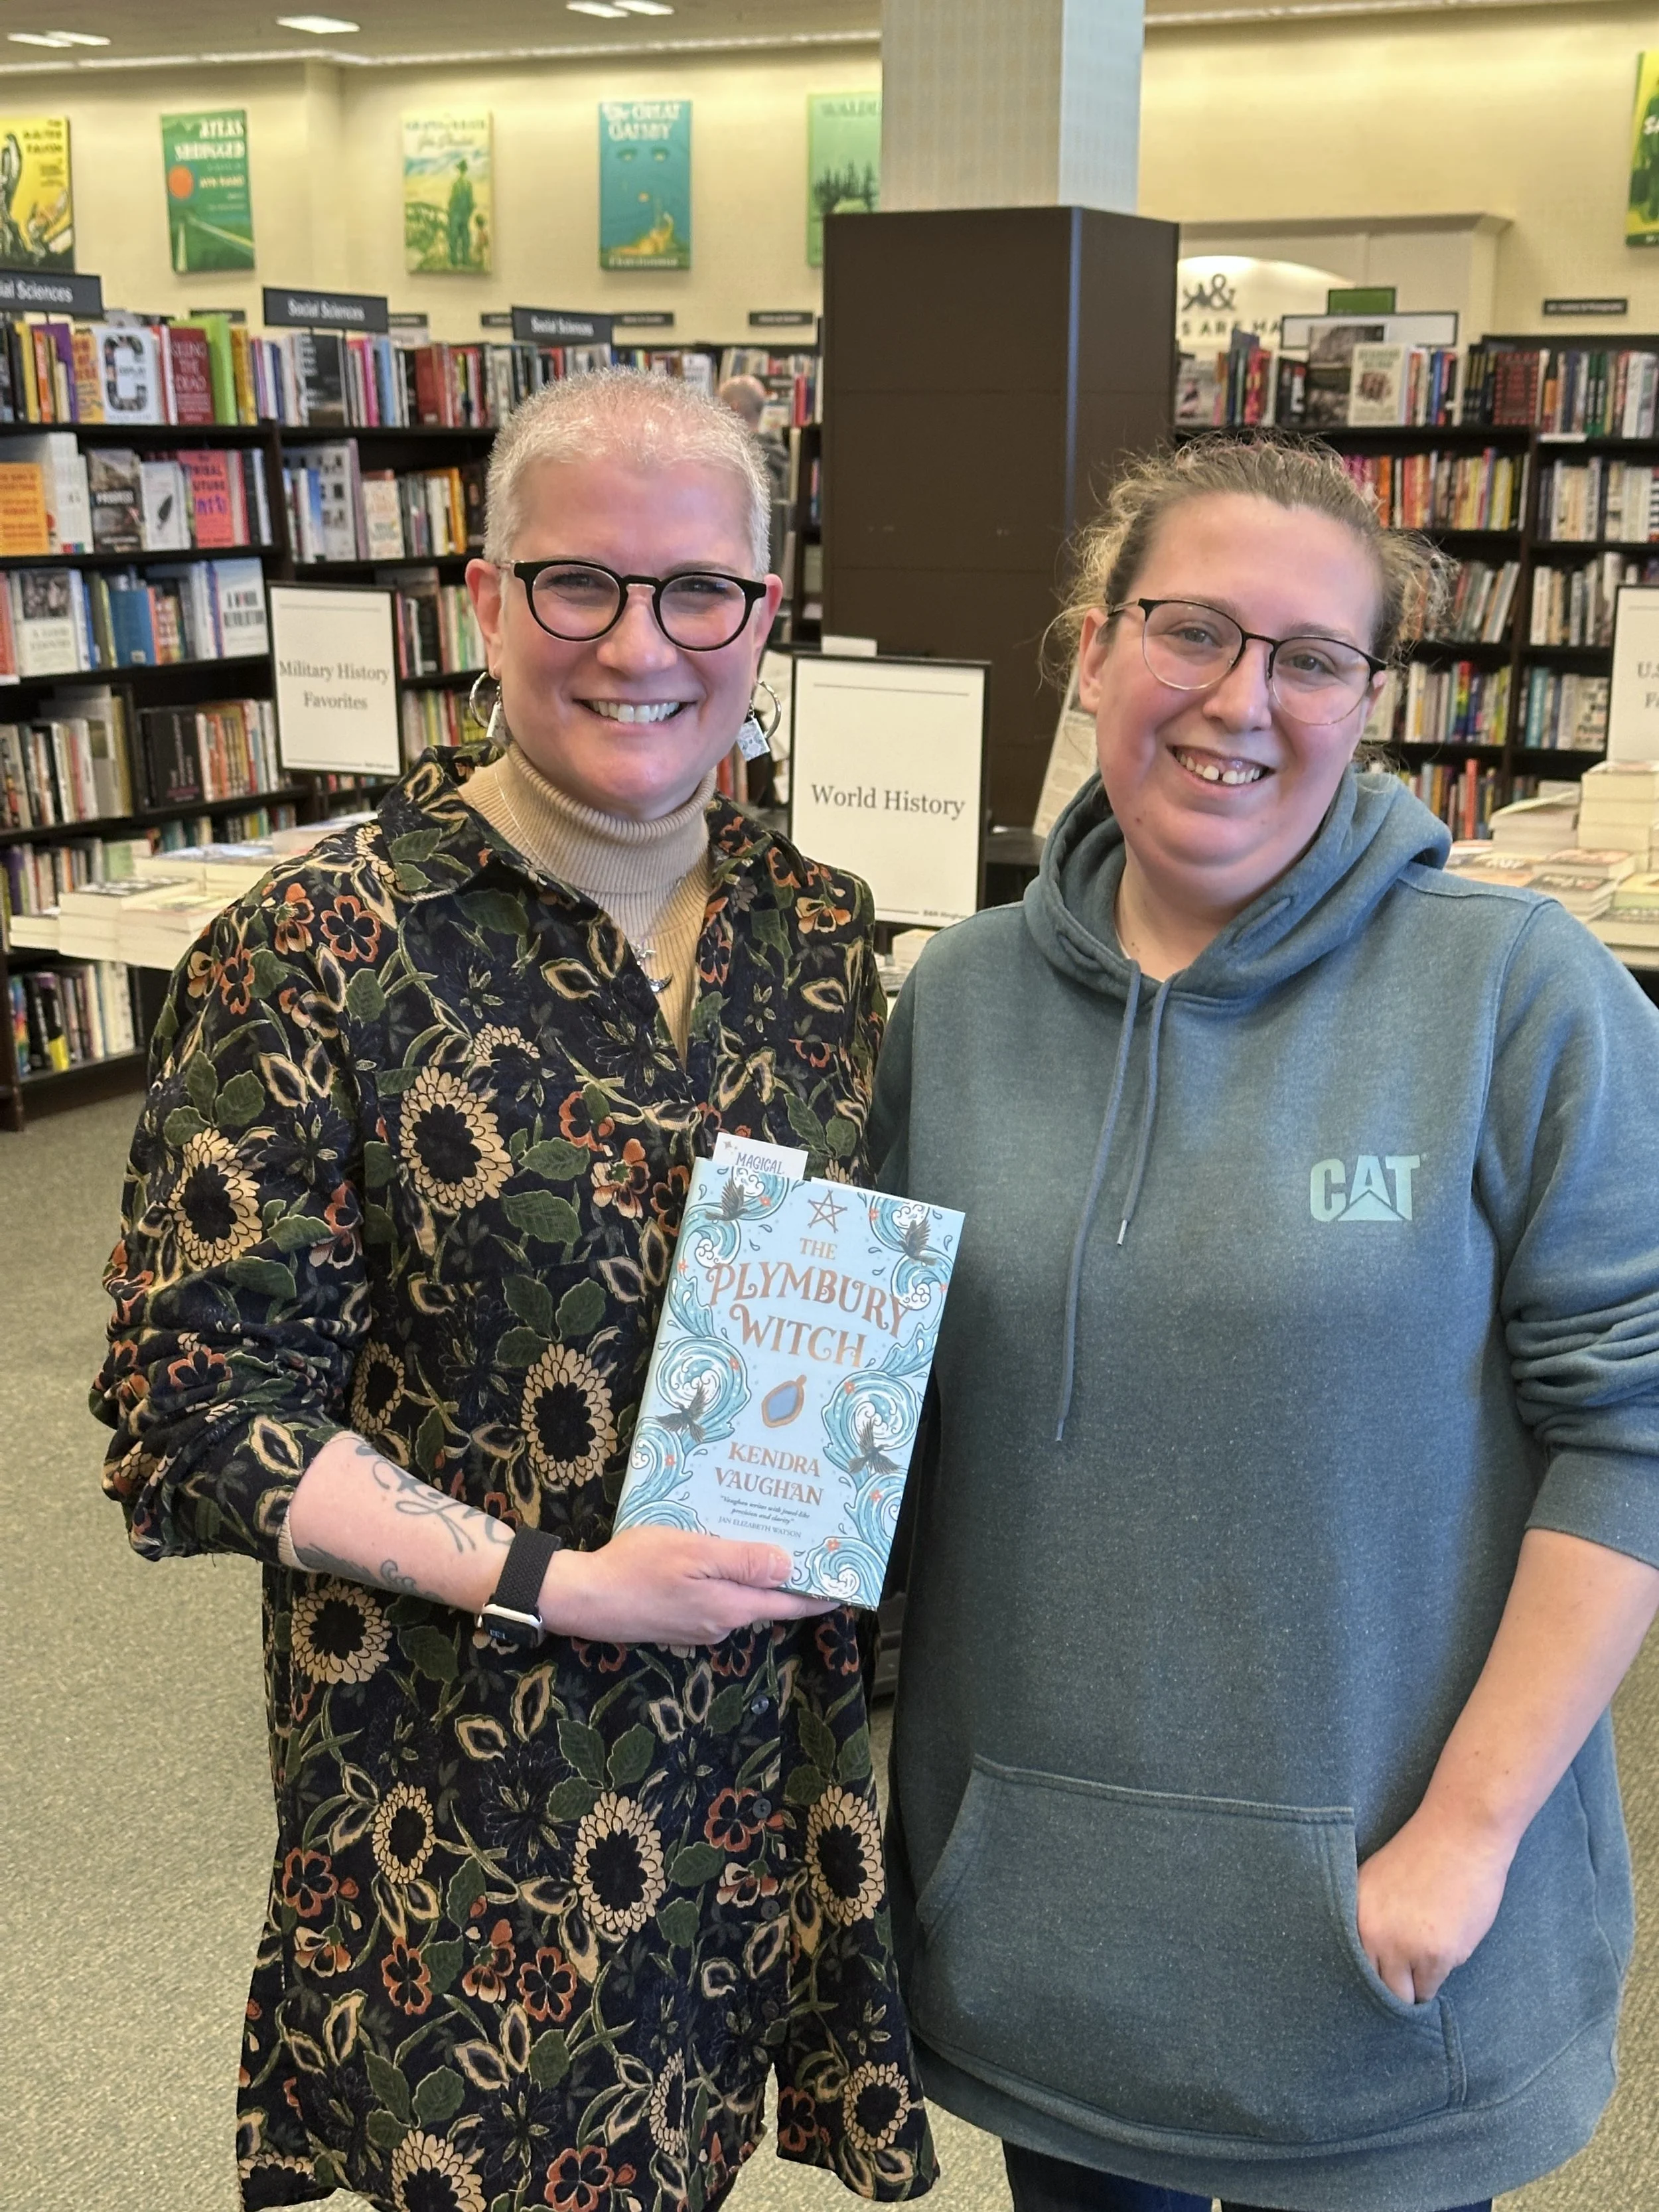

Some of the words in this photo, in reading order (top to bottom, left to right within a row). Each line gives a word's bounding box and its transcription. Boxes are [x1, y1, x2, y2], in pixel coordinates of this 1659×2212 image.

[17, 279, 73, 303] Sciences
[287, 298, 319, 319] Social
[321, 300, 365, 322] Sciences
[279, 659, 334, 683] Military
[337, 662, 390, 686] History
[303, 690, 368, 710] Favorites
[812, 784, 877, 809] World
[884, 790, 966, 821] History
[735, 1152, 783, 1175] MAGICAL
[1310, 1155, 1421, 1222] CAT
[800, 1237, 838, 1260] THE
[705, 1261, 913, 1339] PLYMBURY
[729, 1303, 867, 1368] WITCH
[729, 1441, 820, 1477] KENDRA
[715, 1467, 824, 1506] VAUGHAN
[731, 1508, 758, 1517] precision
[718, 1516, 732, 1524] JAN
[733, 1518, 771, 1532] ELIZABETH
[772, 1526, 802, 1538] WATSON
